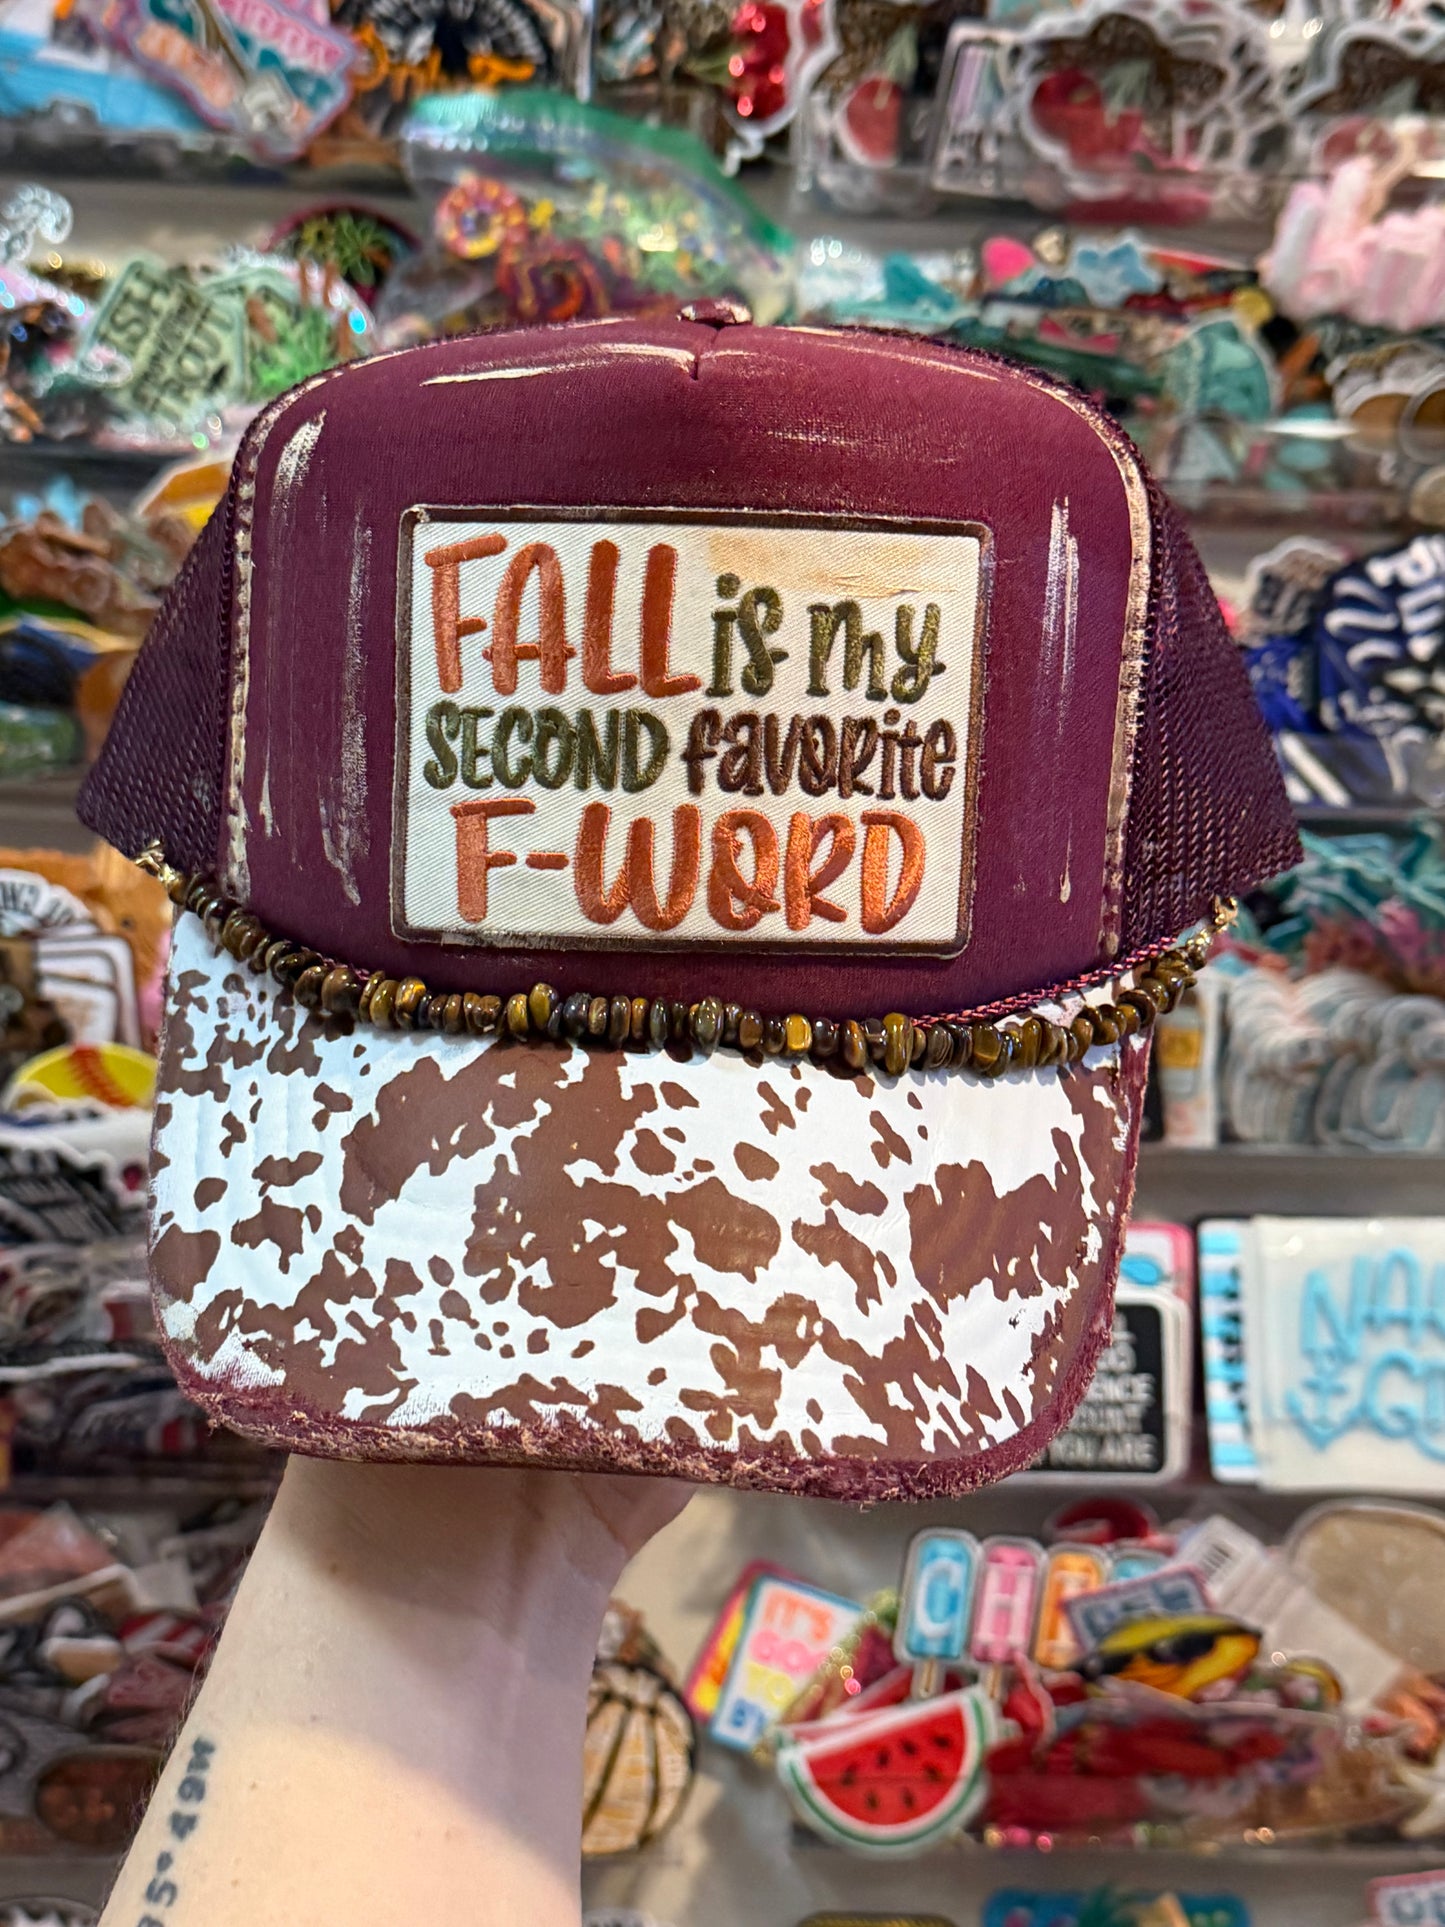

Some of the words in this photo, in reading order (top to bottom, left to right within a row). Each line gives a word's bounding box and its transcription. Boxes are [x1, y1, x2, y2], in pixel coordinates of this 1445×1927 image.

[424, 532, 701, 698] FALL
[706, 572, 789, 698] is
[807, 599, 947, 704] my
[423, 699, 670, 793] SECOND
[450, 798, 926, 935] F-WORD
